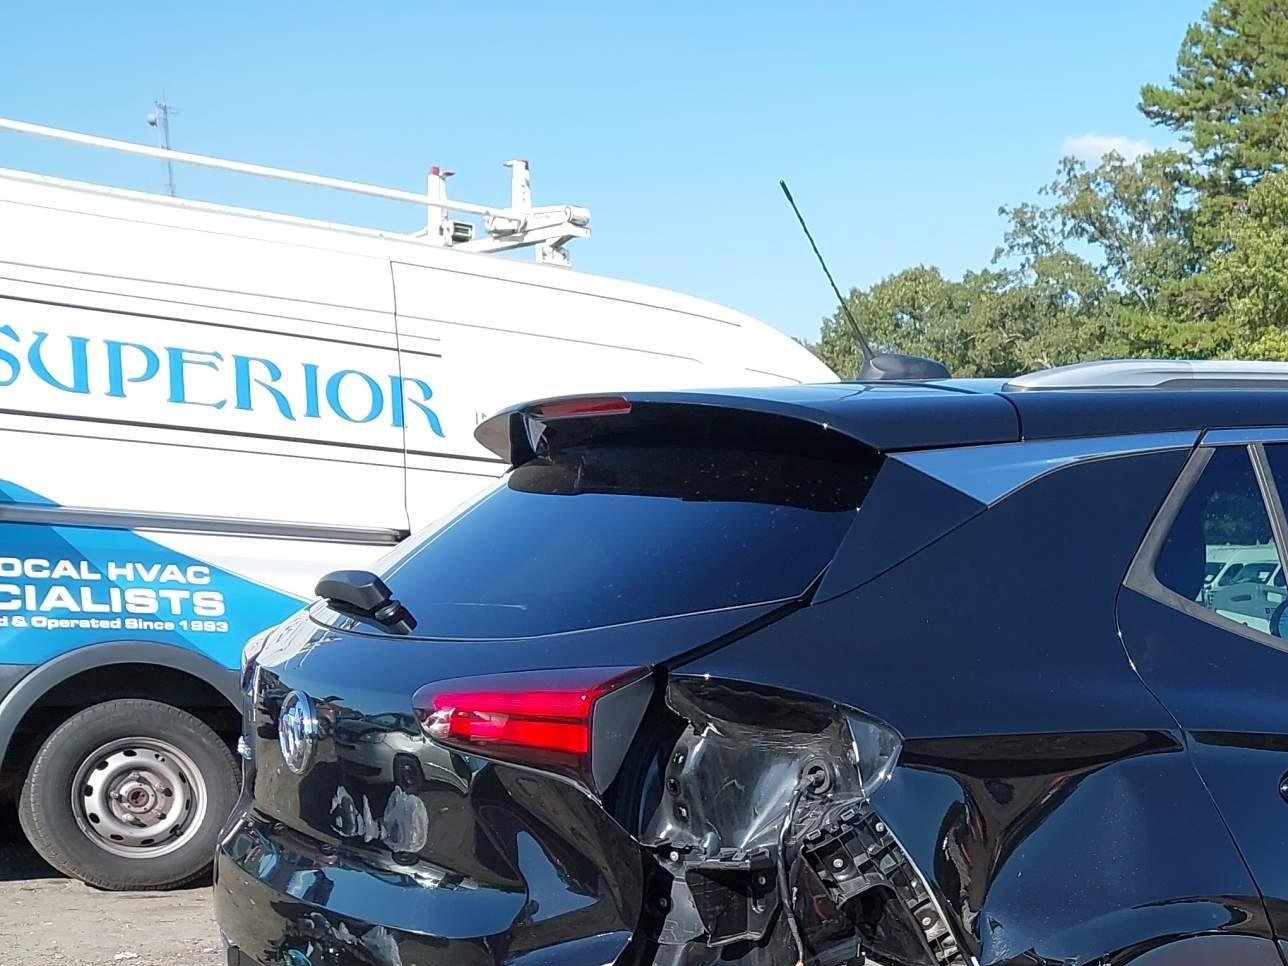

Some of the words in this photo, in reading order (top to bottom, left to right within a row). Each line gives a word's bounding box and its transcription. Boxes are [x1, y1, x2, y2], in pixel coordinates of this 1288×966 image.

[107, 562, 211, 585] HVAC
[11, 615, 29, 628] &
[31, 616, 121, 631] Operated
[124, 618, 175, 631] Since
[179, 620, 229, 633] 1993
